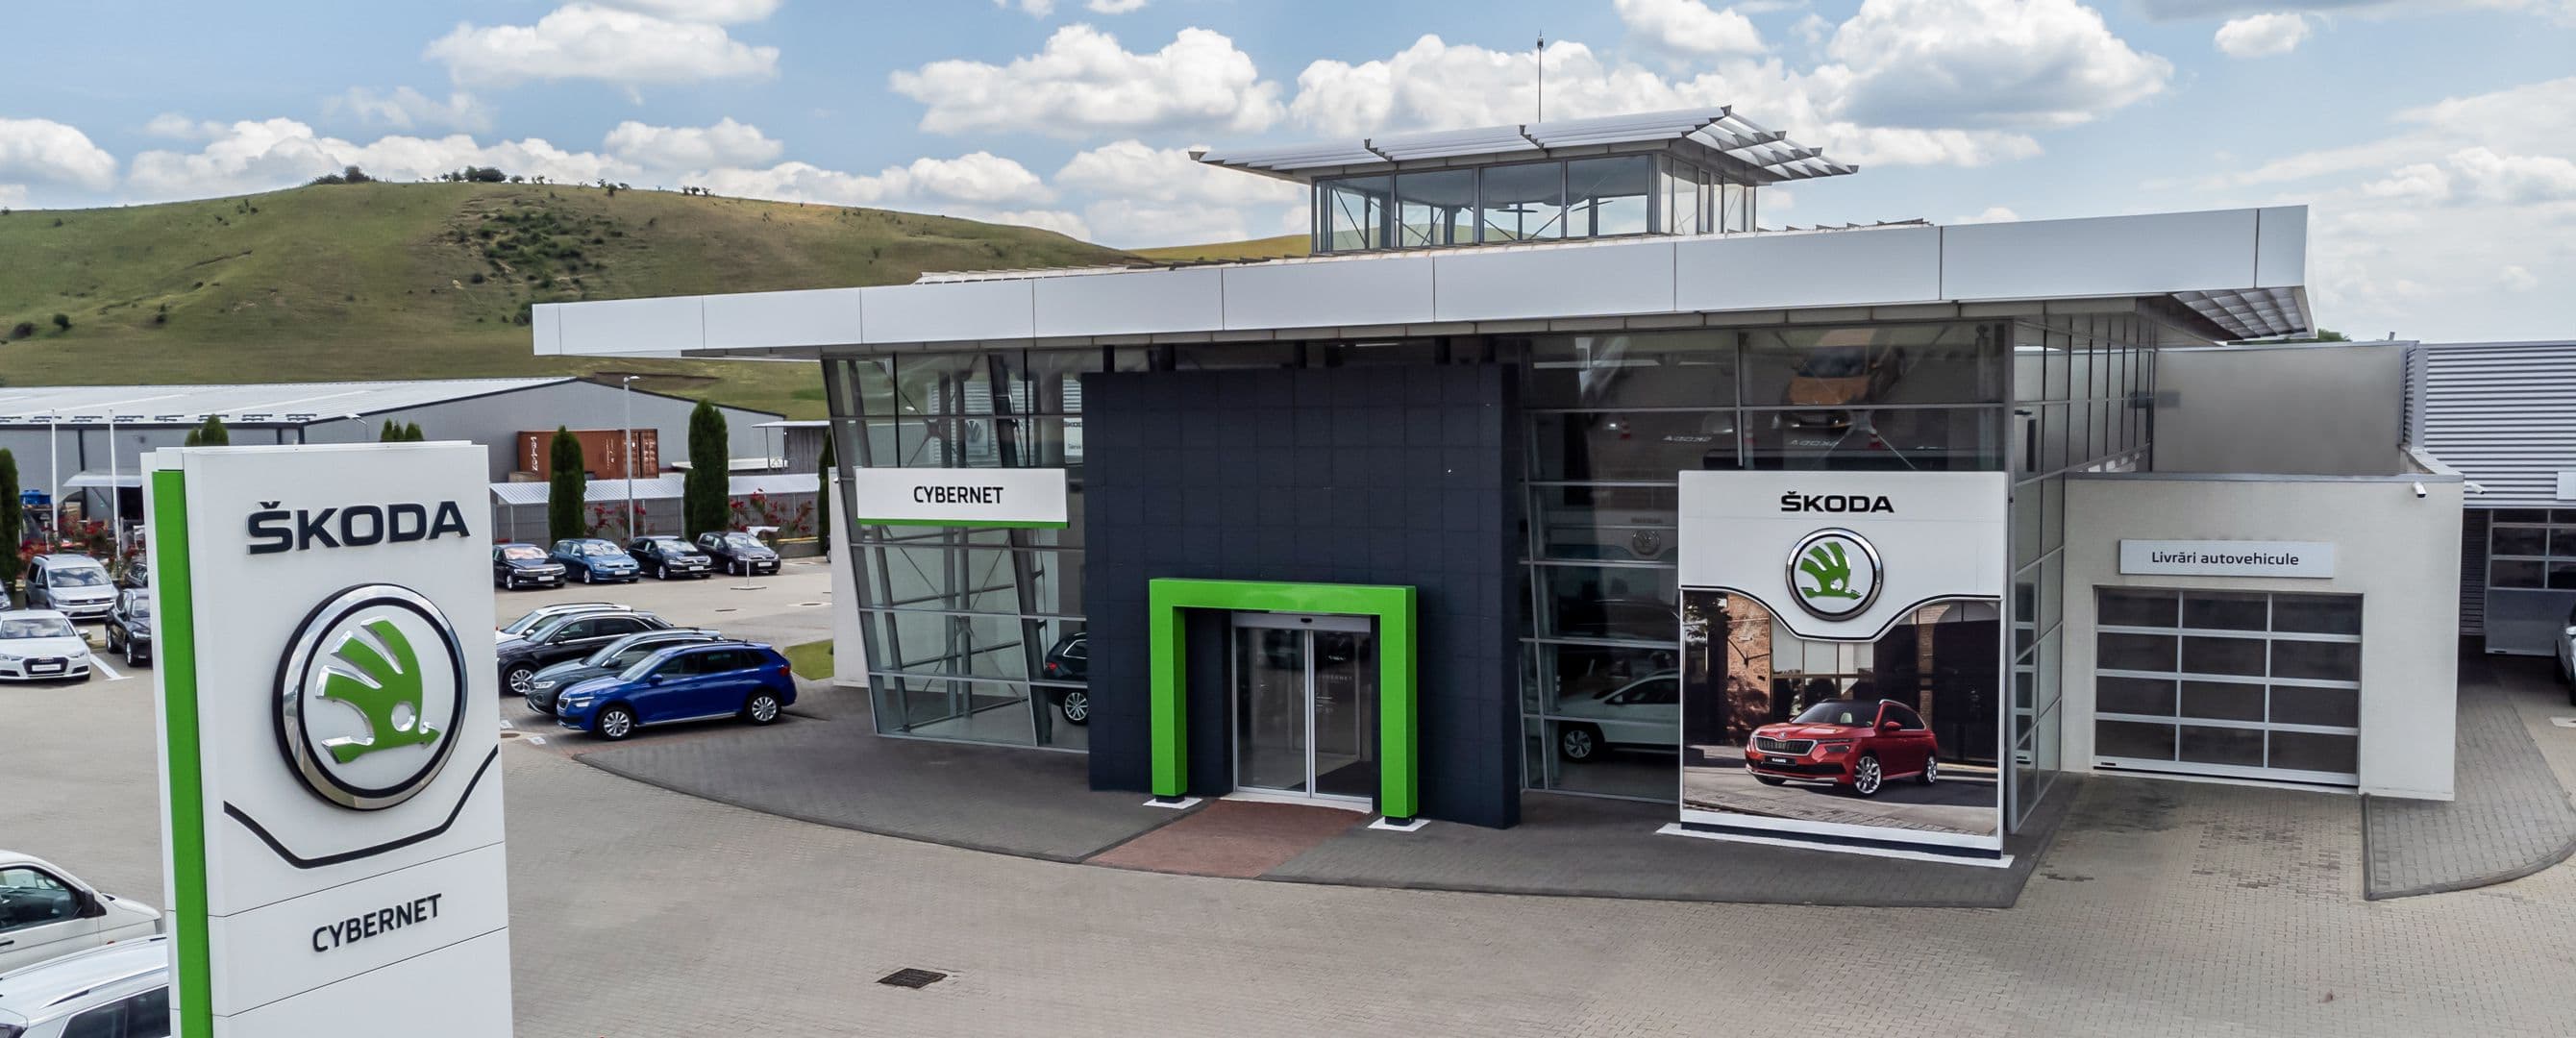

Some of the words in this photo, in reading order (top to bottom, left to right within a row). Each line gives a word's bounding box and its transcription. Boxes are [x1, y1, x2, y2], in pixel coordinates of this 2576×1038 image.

[913, 485, 1004, 504] CYBERNET
[1780, 490, 1895, 513] ŠKODA
[245, 500, 471, 556] ŠKODA
[2200, 553, 2299, 565] autovehicule
[312, 893, 442, 952] CYBERNET
